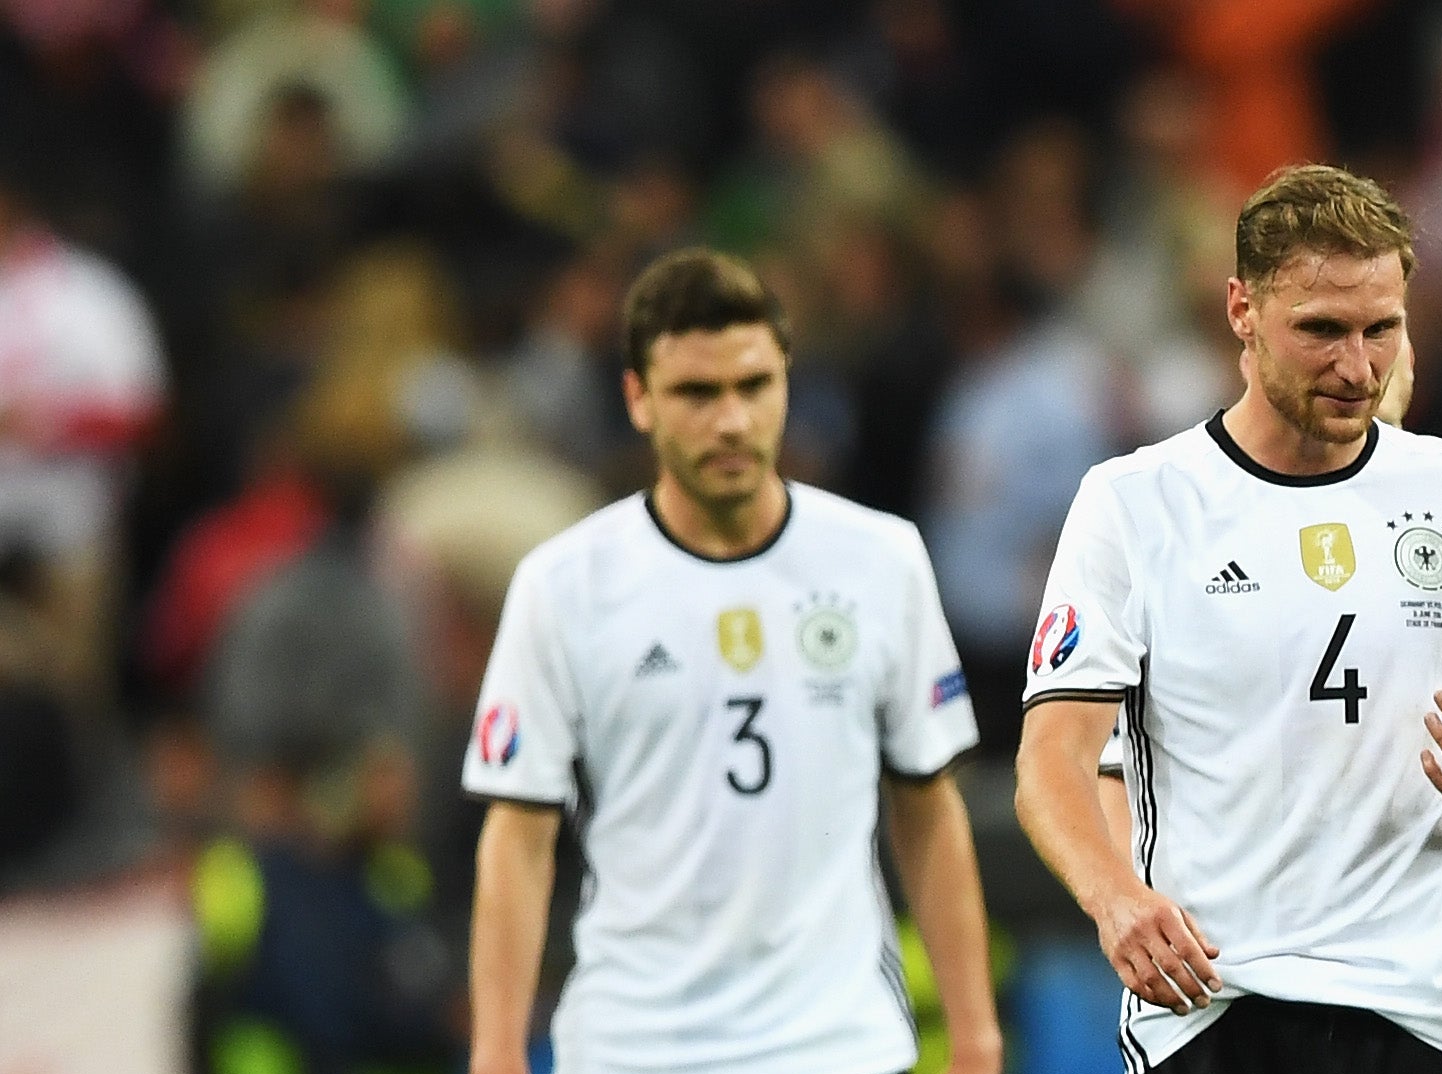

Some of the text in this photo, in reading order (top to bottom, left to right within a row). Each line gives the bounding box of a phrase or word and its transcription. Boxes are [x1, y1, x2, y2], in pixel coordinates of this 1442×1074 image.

[1206, 580, 1260, 595] adidas
[1309, 613, 1368, 724] 4
[724, 696, 772, 796] 3
